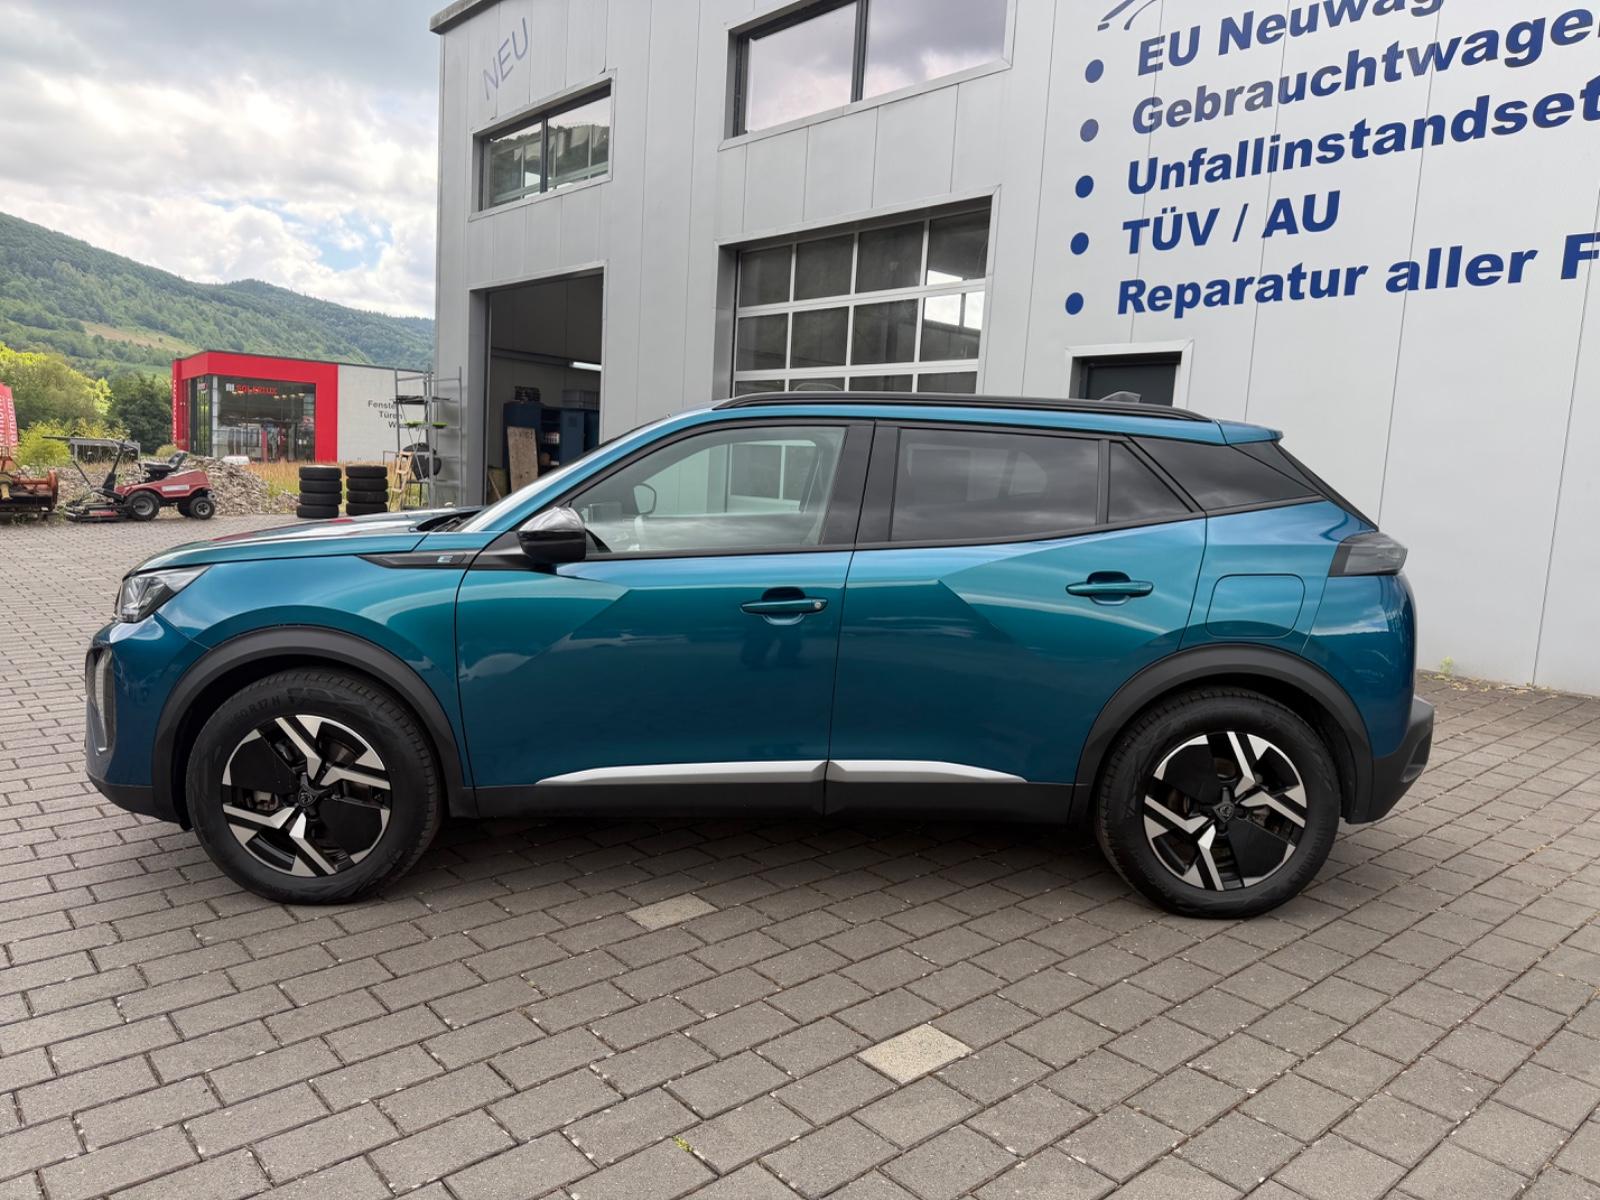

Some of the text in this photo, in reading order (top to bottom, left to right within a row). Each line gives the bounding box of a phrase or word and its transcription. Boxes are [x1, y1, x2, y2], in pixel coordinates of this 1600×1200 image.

[482, 17, 528, 101] NEU
[1133, 8, 1600, 134] Gebrauchtwage
[1138, 26, 1200, 75] EU
[1128, 74, 1600, 197] Unfallinstandset
[1122, 206, 1220, 256] TÜV
[1262, 191, 1341, 239] AU
[1117, 232, 1600, 320] Reparatur aller F
[367, 400, 398, 409] Fenste
